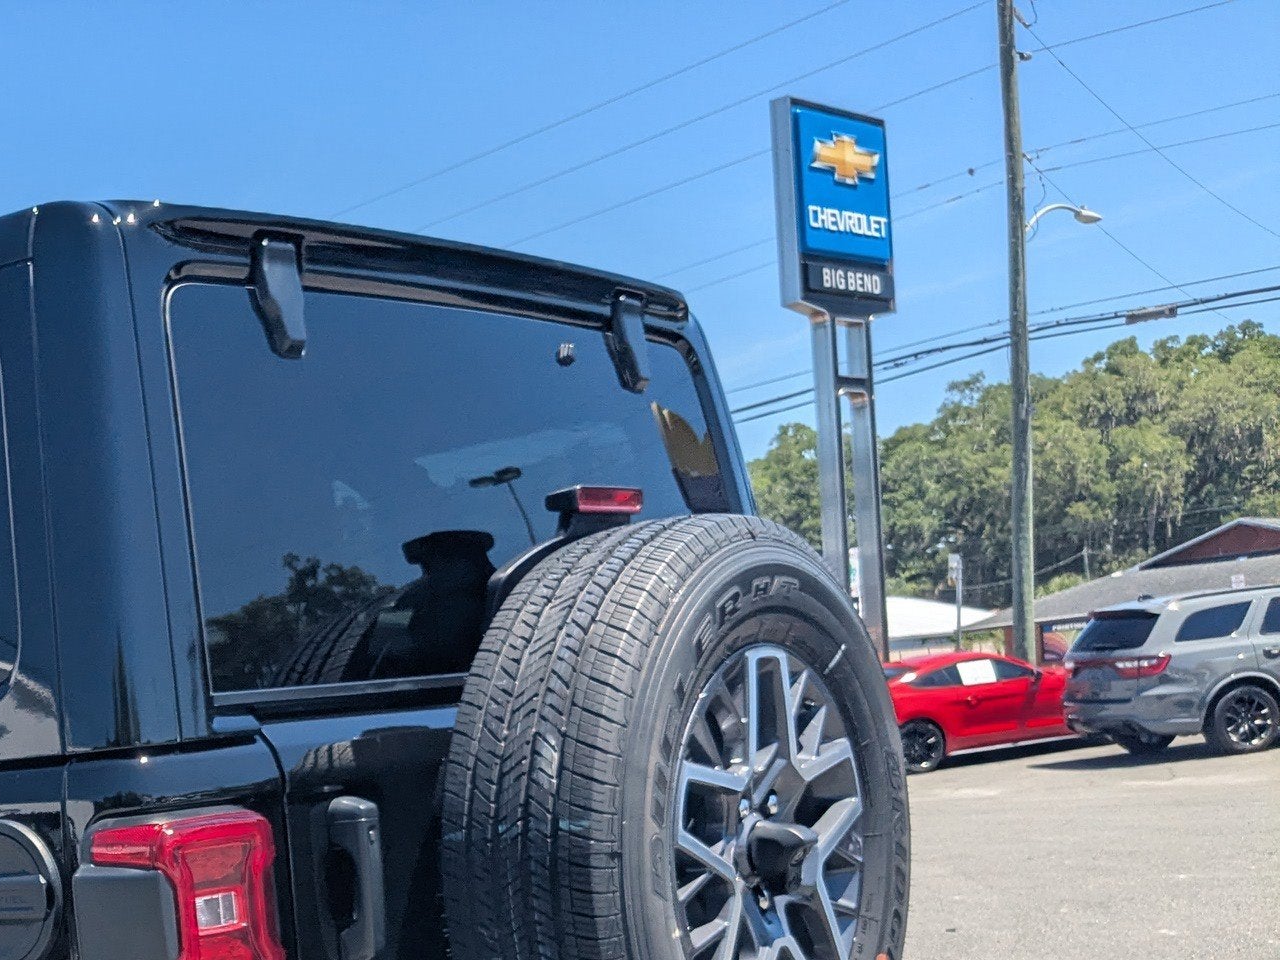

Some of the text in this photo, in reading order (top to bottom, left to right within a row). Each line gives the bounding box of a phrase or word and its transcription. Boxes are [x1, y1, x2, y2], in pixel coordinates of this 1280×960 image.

[808, 205, 888, 238] CHEVROLET
[822, 267, 882, 295] BIG BEND
